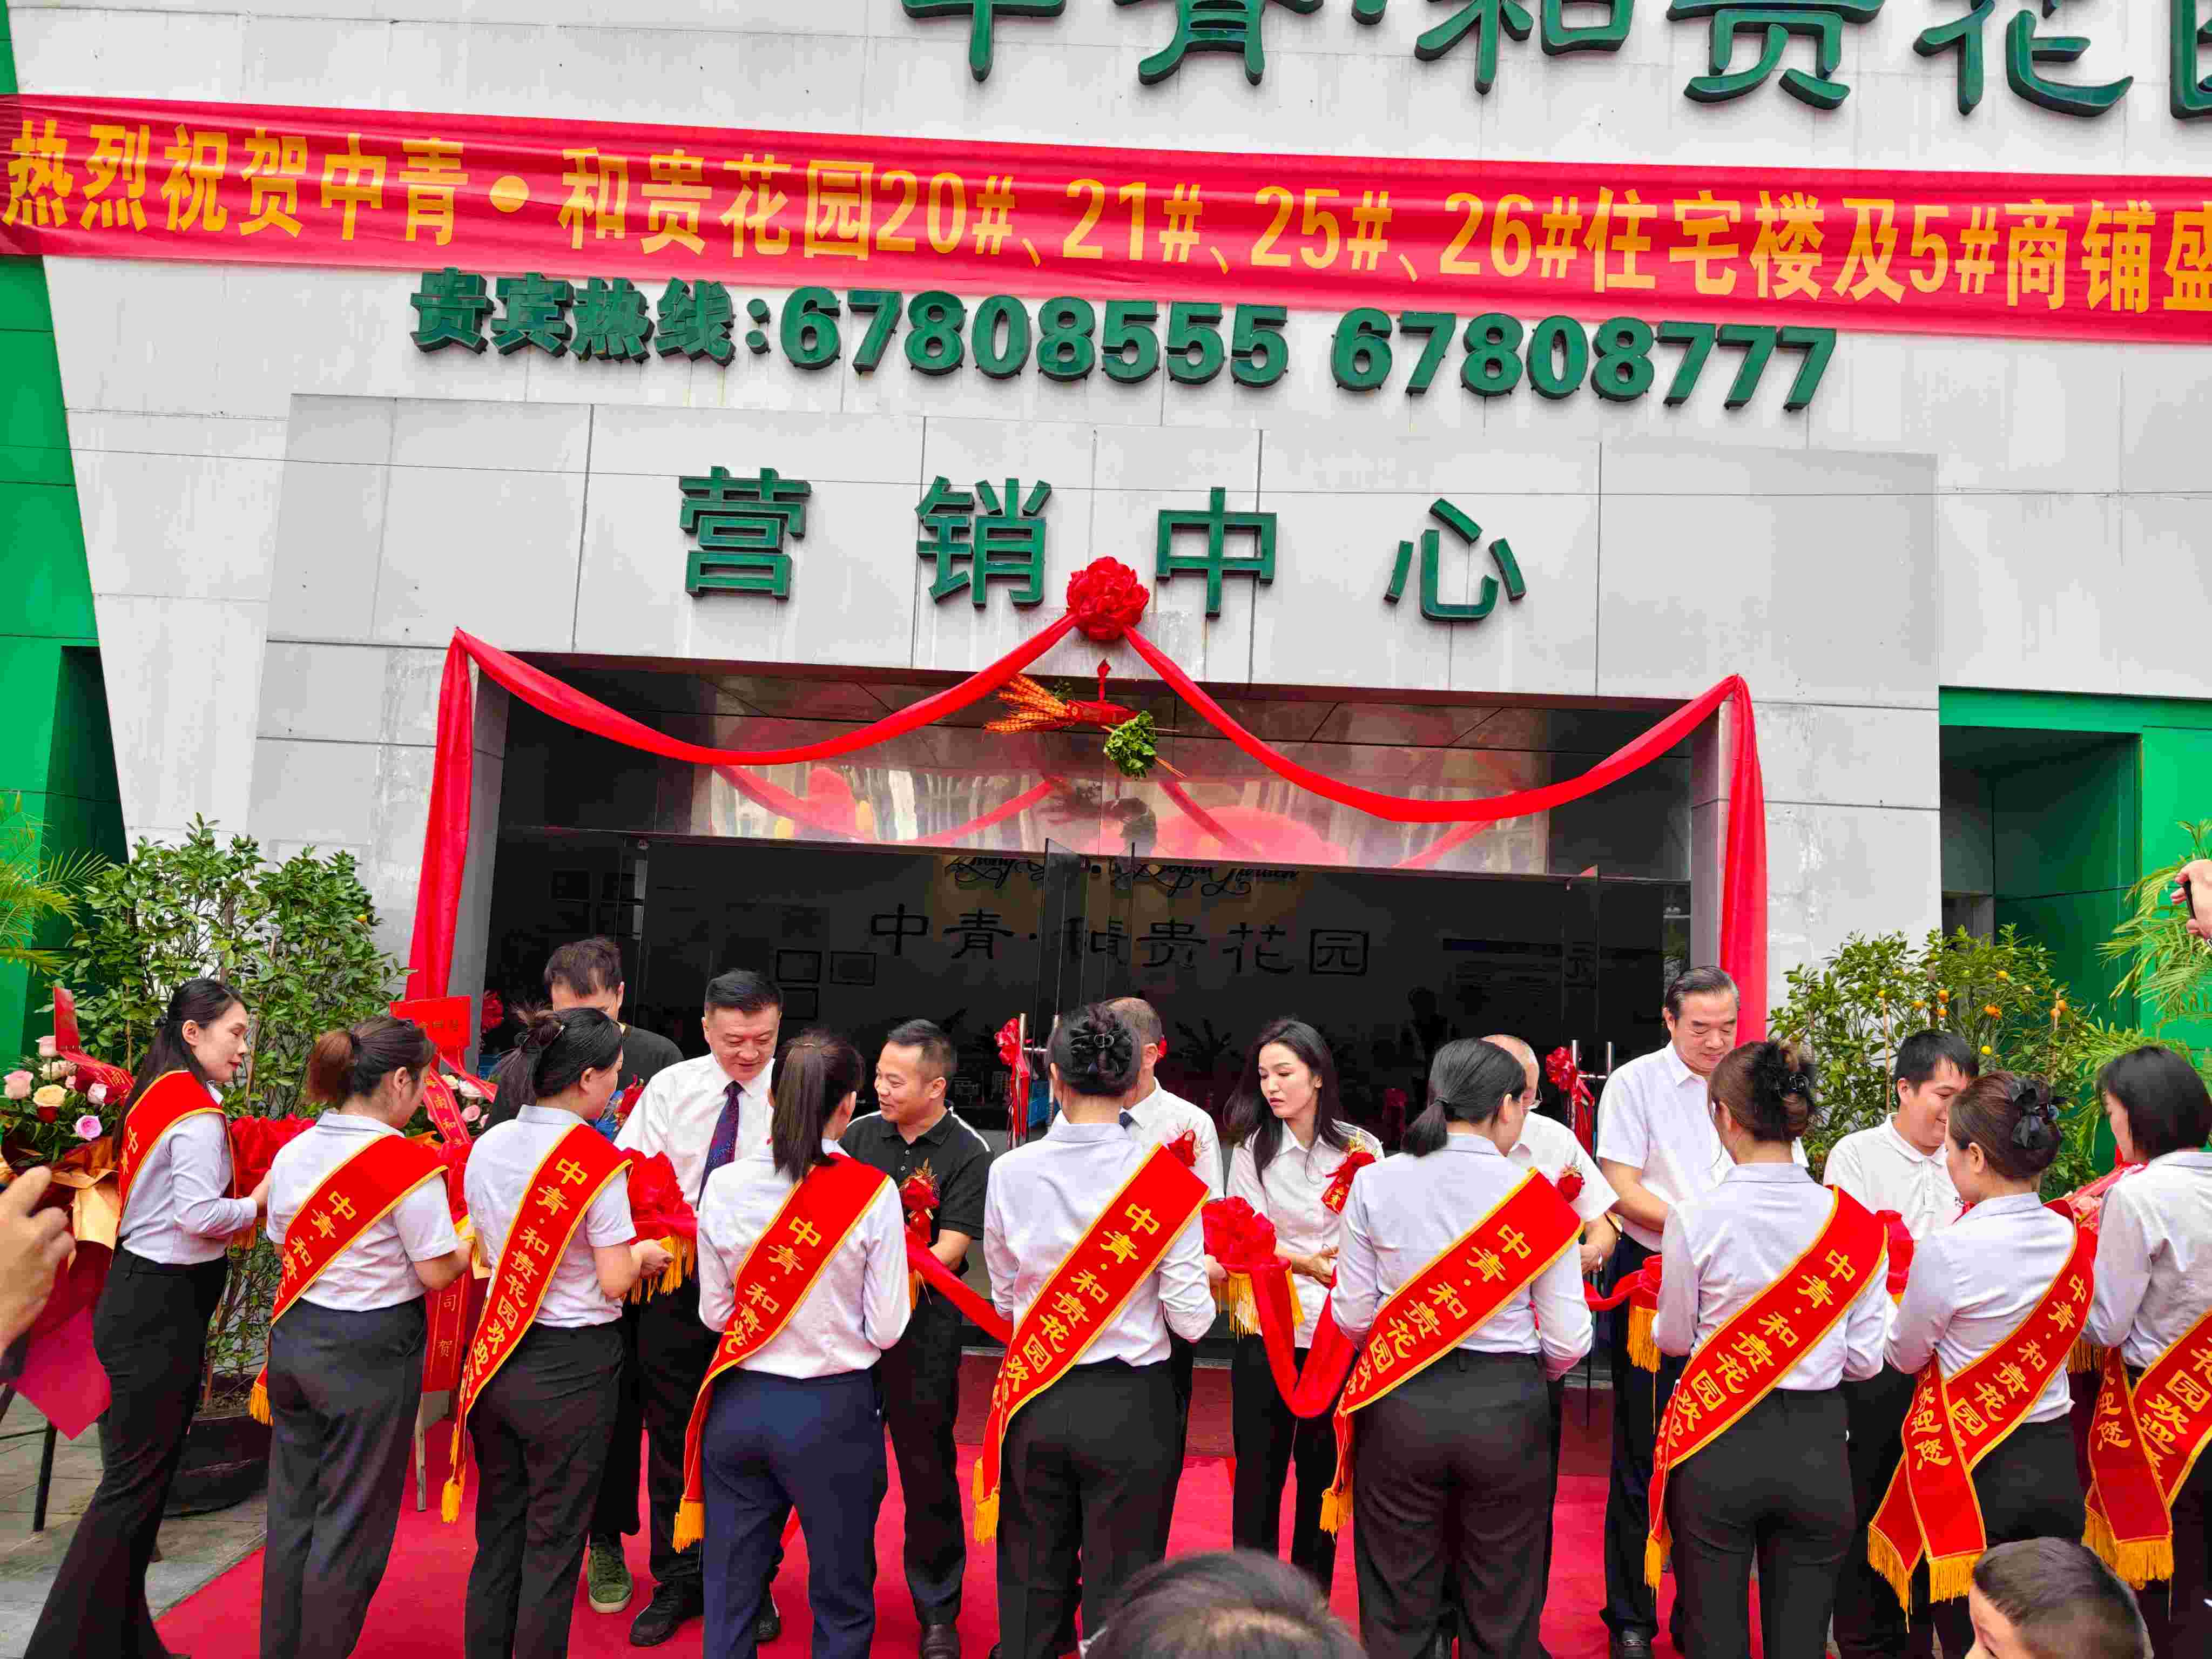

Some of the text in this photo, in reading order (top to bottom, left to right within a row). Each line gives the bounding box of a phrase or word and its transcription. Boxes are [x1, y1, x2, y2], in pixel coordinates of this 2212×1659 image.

[1330, 307, 1836, 413] 67808777
[678, 465, 1526, 623] 营销中心
